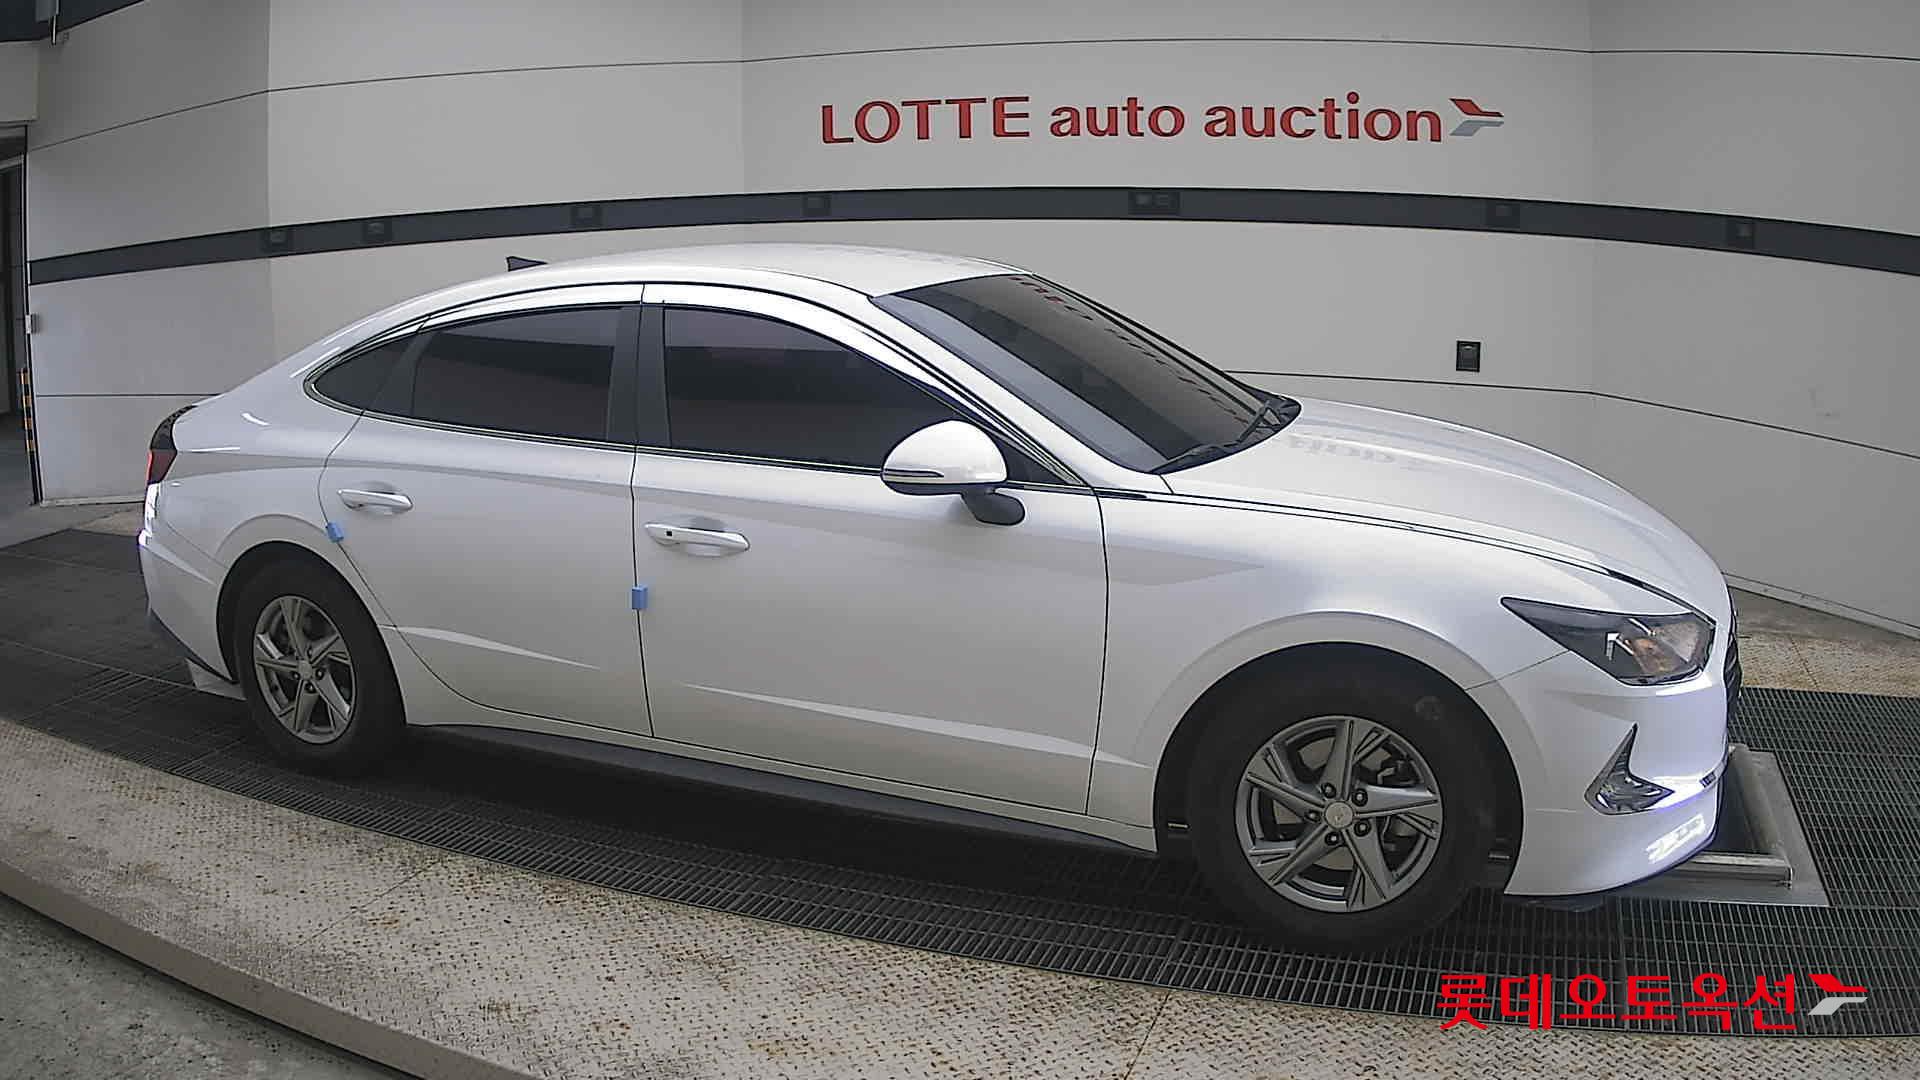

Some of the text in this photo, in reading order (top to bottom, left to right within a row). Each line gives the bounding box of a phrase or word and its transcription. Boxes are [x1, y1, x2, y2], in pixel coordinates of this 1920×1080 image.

[822, 91, 1442, 145] LOTTE auto auction
